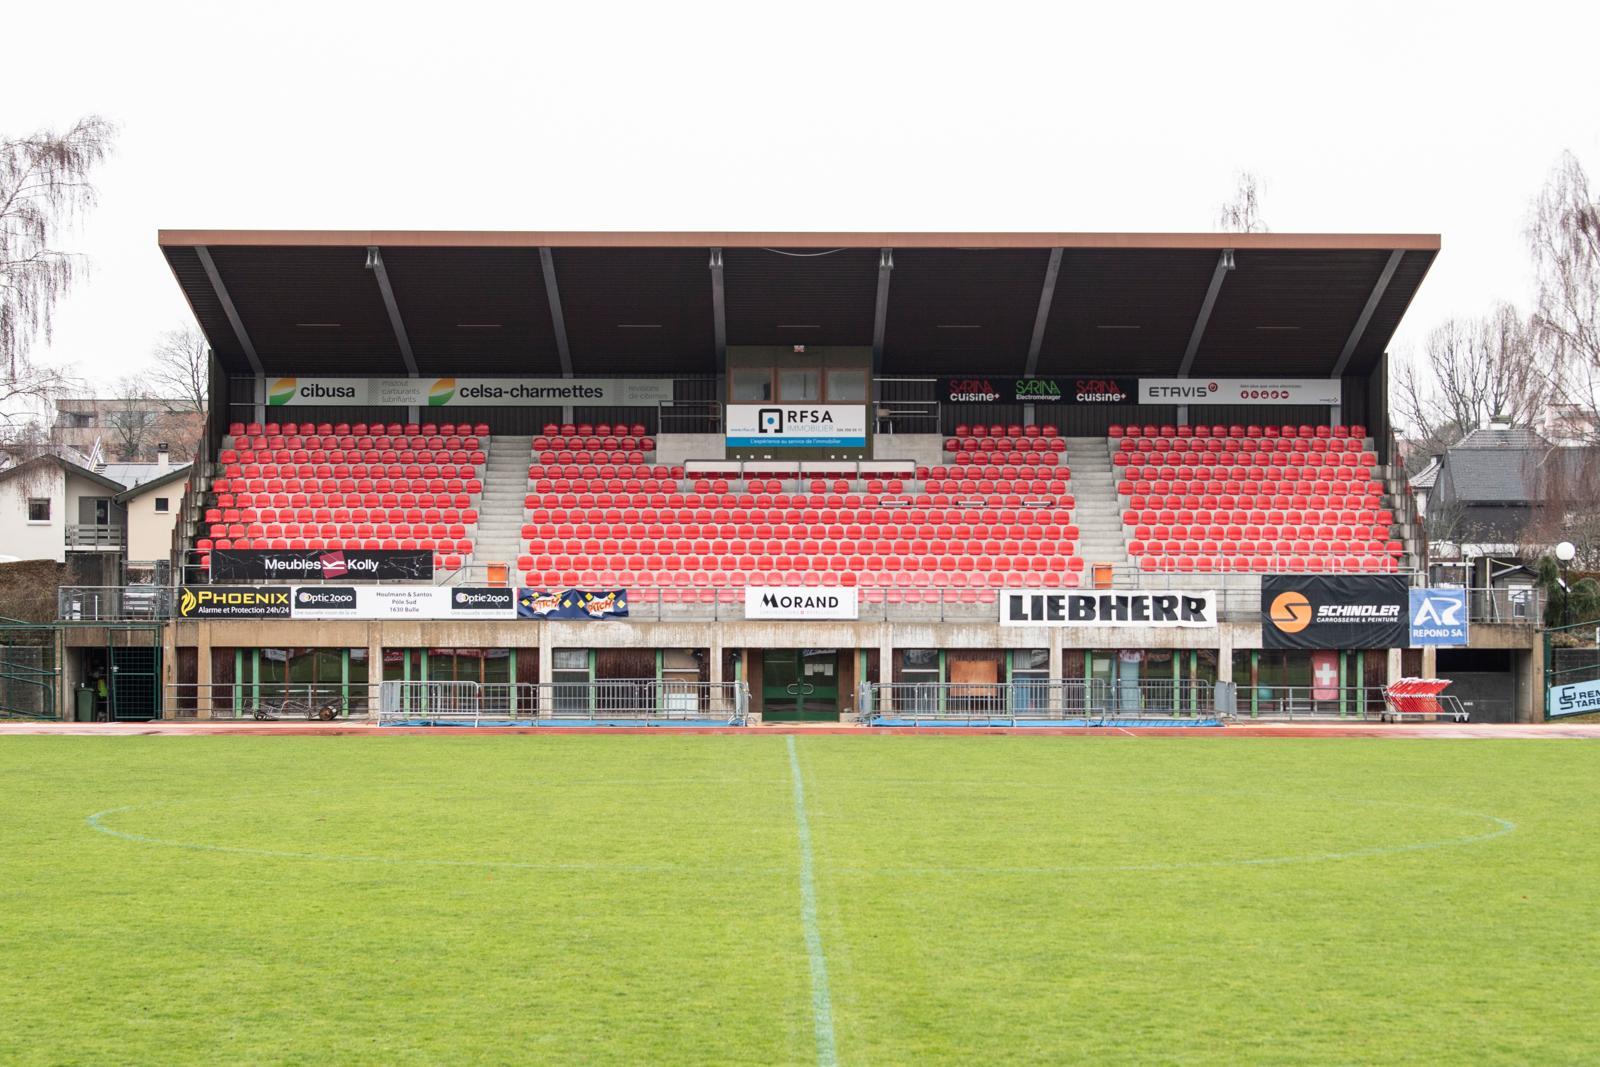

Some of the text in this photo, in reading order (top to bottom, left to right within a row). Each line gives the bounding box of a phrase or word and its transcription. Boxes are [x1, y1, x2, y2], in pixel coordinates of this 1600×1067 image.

[300, 383, 355, 398] cibusa
[459, 384, 604, 398] celsa-charmettes
[950, 380, 994, 393] SARINA
[1015, 380, 1061, 394] SARINA
[1075, 380, 1120, 393] SARINA
[1149, 386, 1207, 398] ETAVIS
[950, 392, 1000, 402] cuisine+
[1076, 392, 1126, 402] cuisine+
[787, 410, 833, 423] RFSA
[787, 424, 834, 432] IMMOBILIER
[265, 559, 379, 572] Meubles Kolly
[198, 591, 289, 605] PHOENIX
[760, 593, 839, 608] MORAND
[198, 606, 222, 614] Alarme
[231, 606, 265, 614] Protection
[266, 606, 290, 614] 24h/24
[1009, 594, 1208, 622] LIEBHERR
[1317, 605, 1400, 616] SCHINDLER
[1413, 629, 1463, 638] REPOND SA
